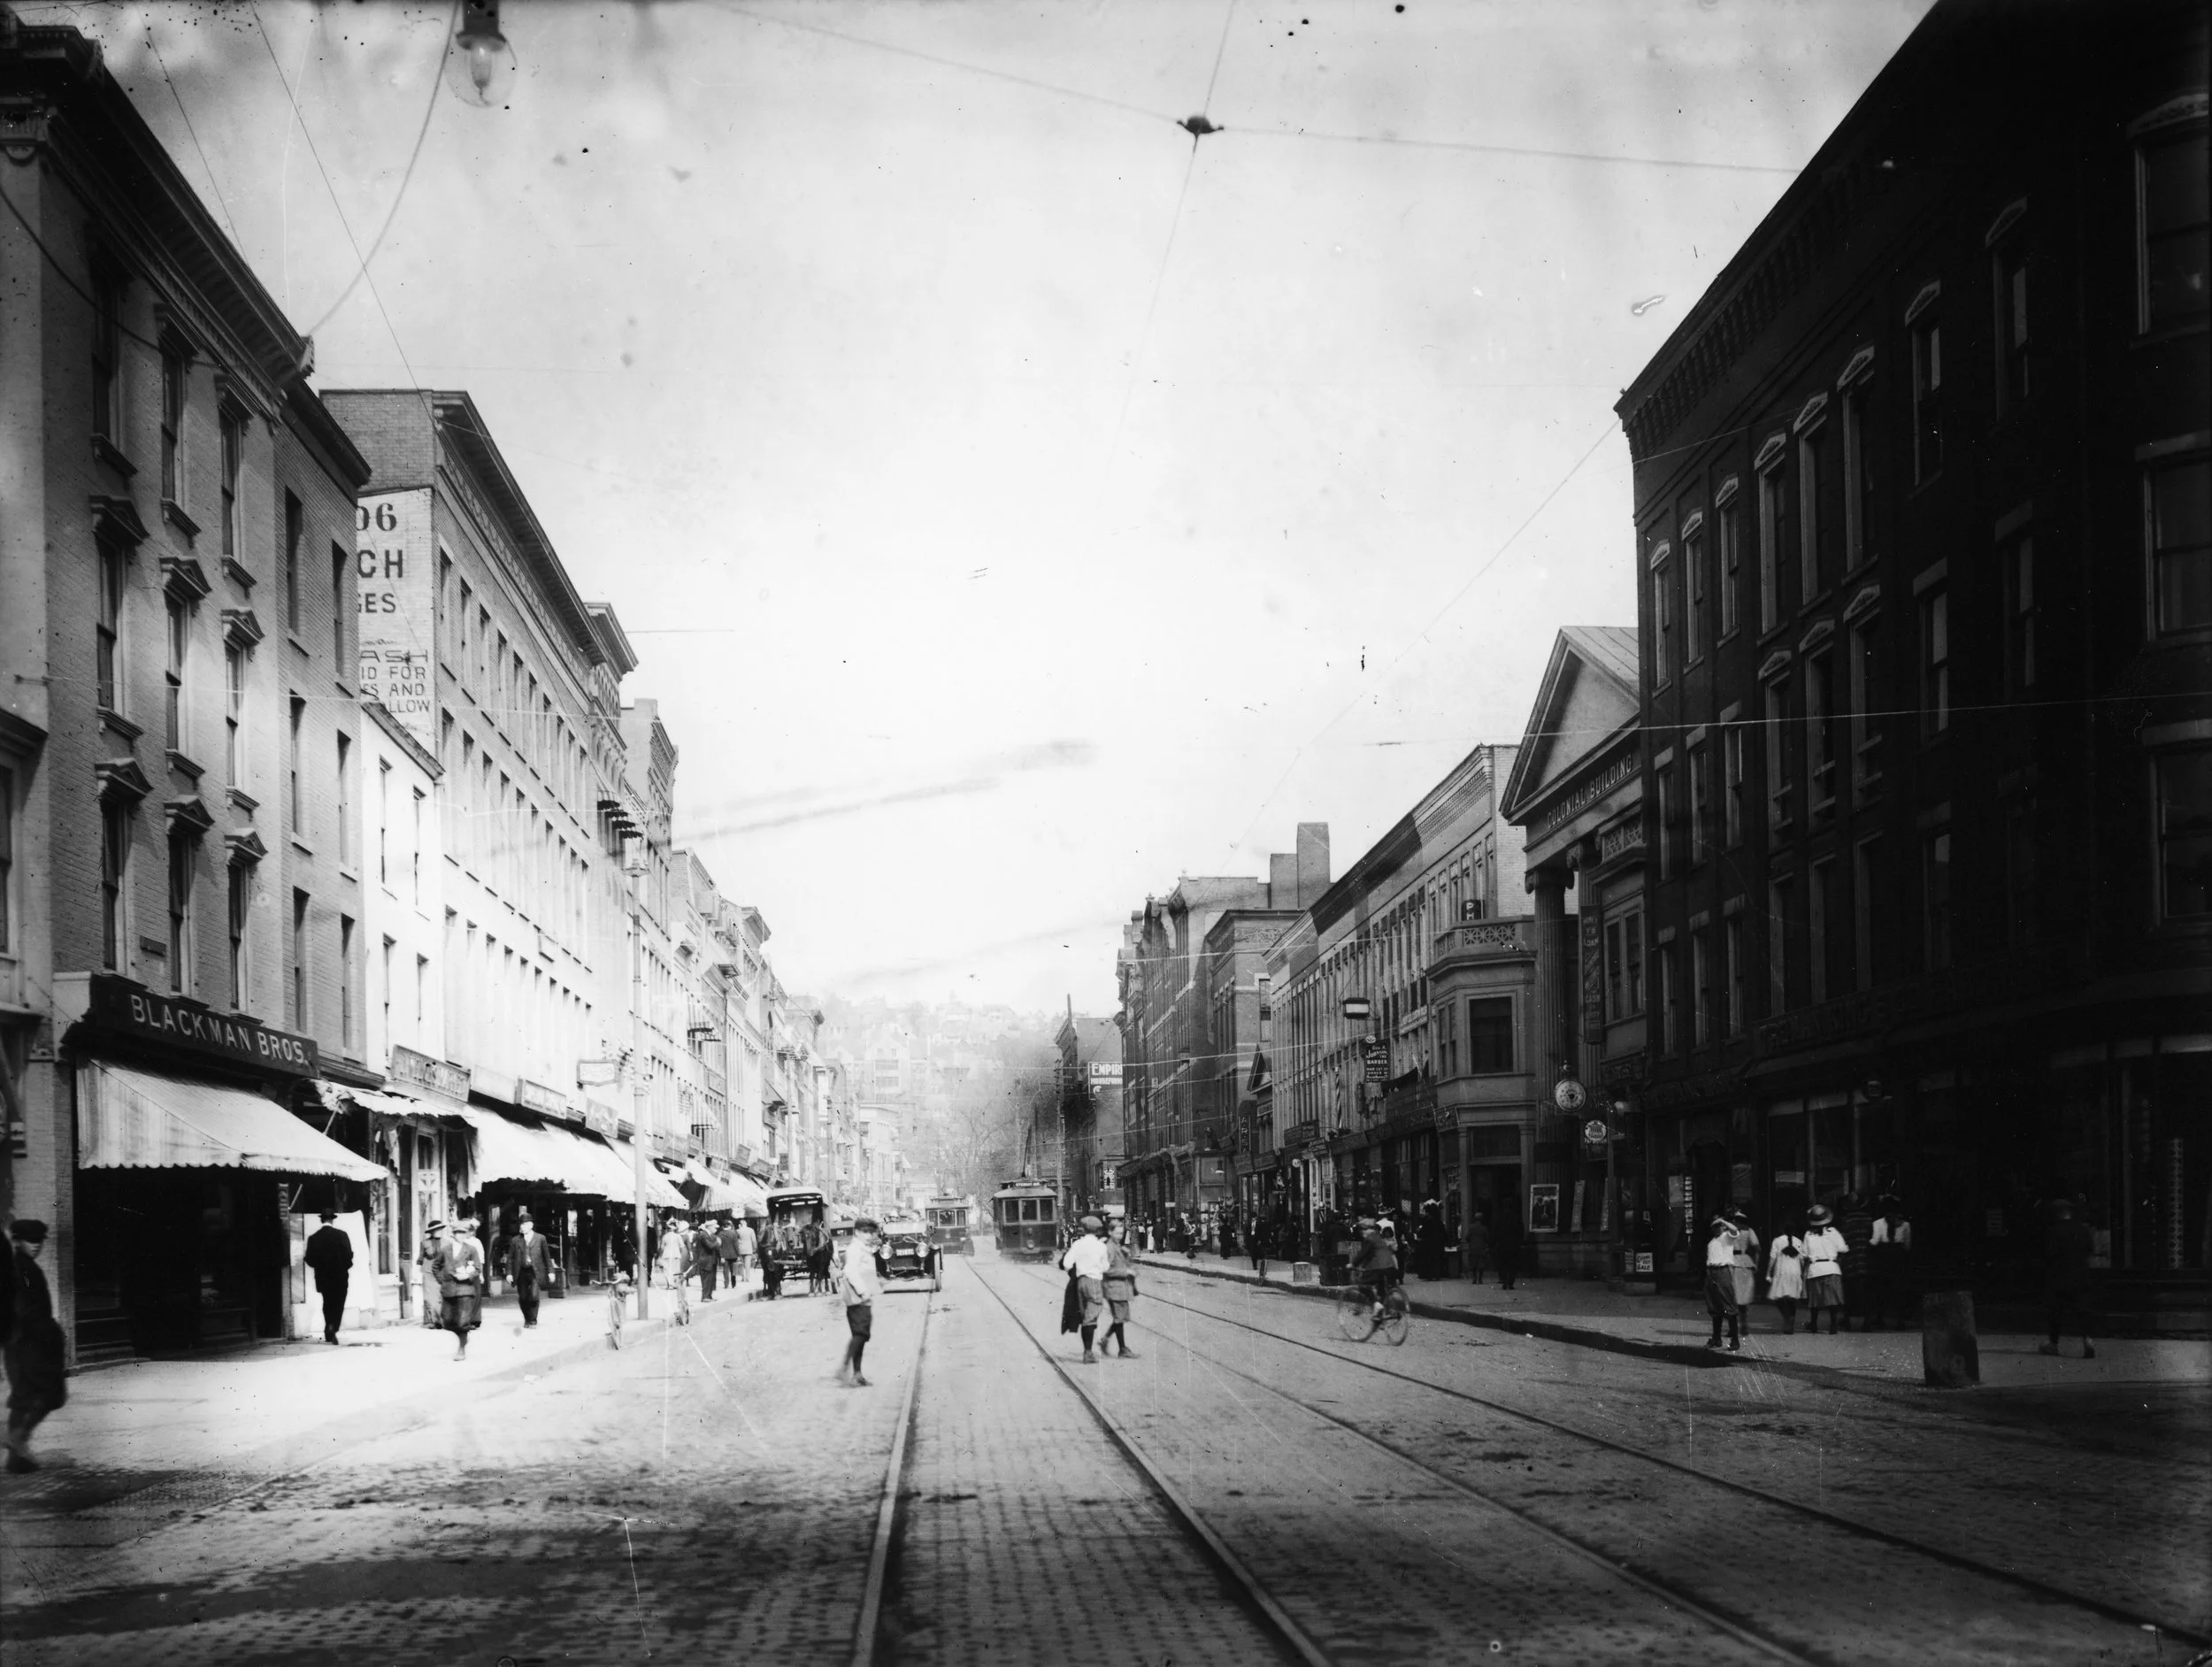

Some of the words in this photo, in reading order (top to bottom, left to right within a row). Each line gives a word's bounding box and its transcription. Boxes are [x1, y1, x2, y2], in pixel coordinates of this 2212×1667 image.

[389, 666, 426, 680] FOR
[389, 683, 425, 696] AND
[1547, 787, 1586, 829] COLONIAL
[1590, 753, 1632, 799] BUILDING
[131, 995, 251, 1051] BLACKMAN
[257, 1031, 310, 1065] BROS.
